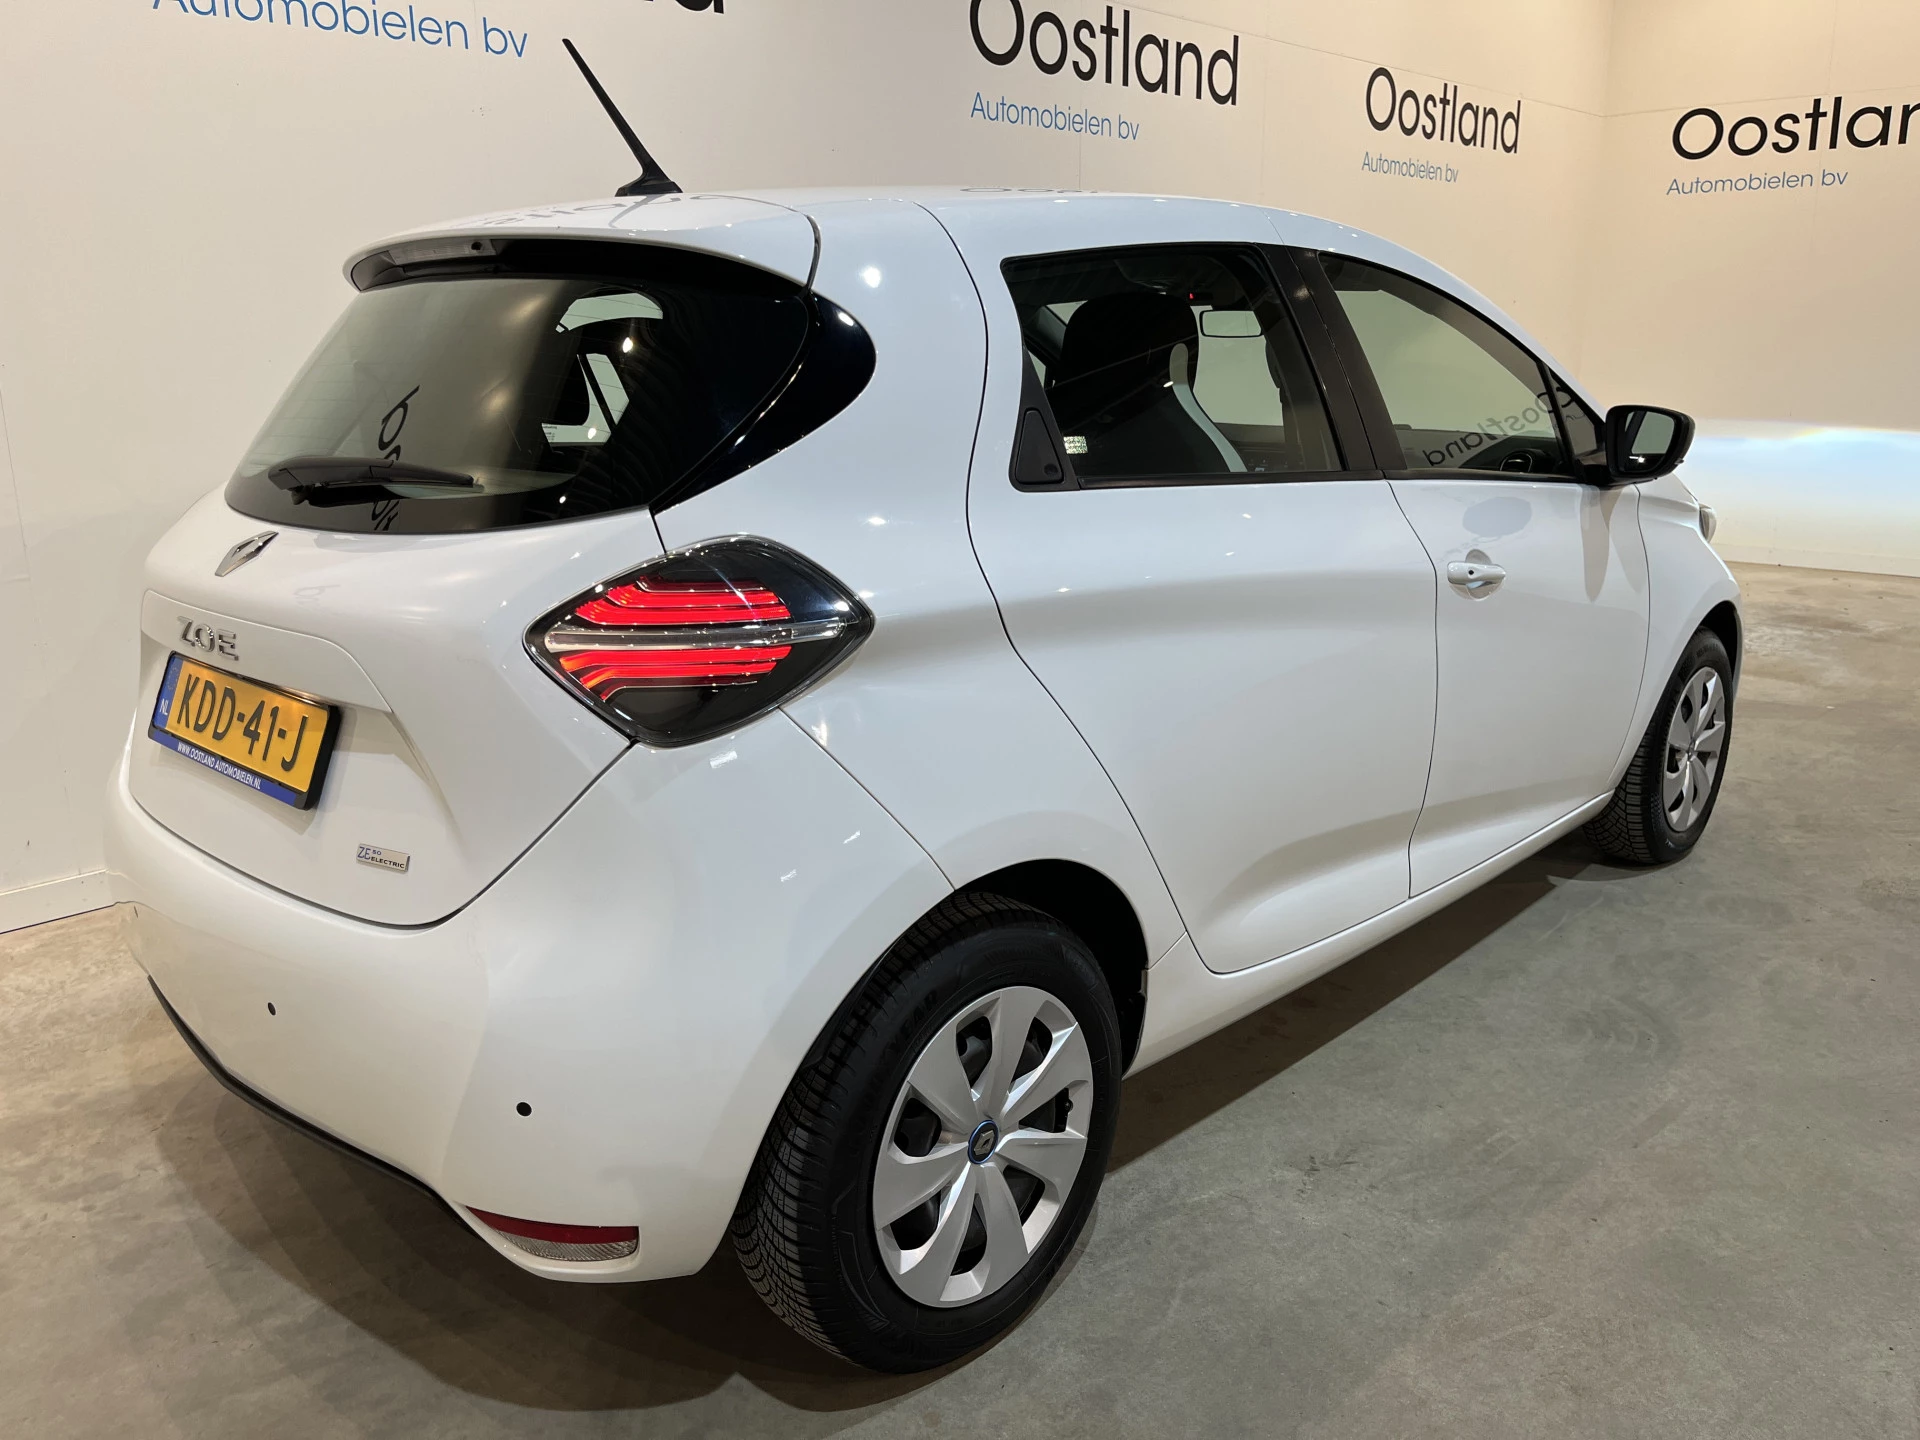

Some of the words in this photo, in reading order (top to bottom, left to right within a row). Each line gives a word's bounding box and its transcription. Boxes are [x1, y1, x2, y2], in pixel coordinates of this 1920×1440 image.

[153, 0, 469, 50] uomobielen
[483, 17, 527, 58] bv
[969, 0, 1240, 106] Oostland
[970, 91, 1112, 137] Automobielen
[1118, 114, 1140, 140] bv
[1366, 66, 1521, 154] Oostland
[1361, 151, 1442, 181] Automobielen
[1445, 163, 1459, 183] bv
[1666, 171, 1814, 195] Automobielen
[1821, 169, 1849, 186] bv
[177, 615, 239, 661] ZOE
[160, 698, 169, 716] NL
[176, 673, 309, 772] KDD-41-J
[371, 856, 405, 868] ELECTRIC
